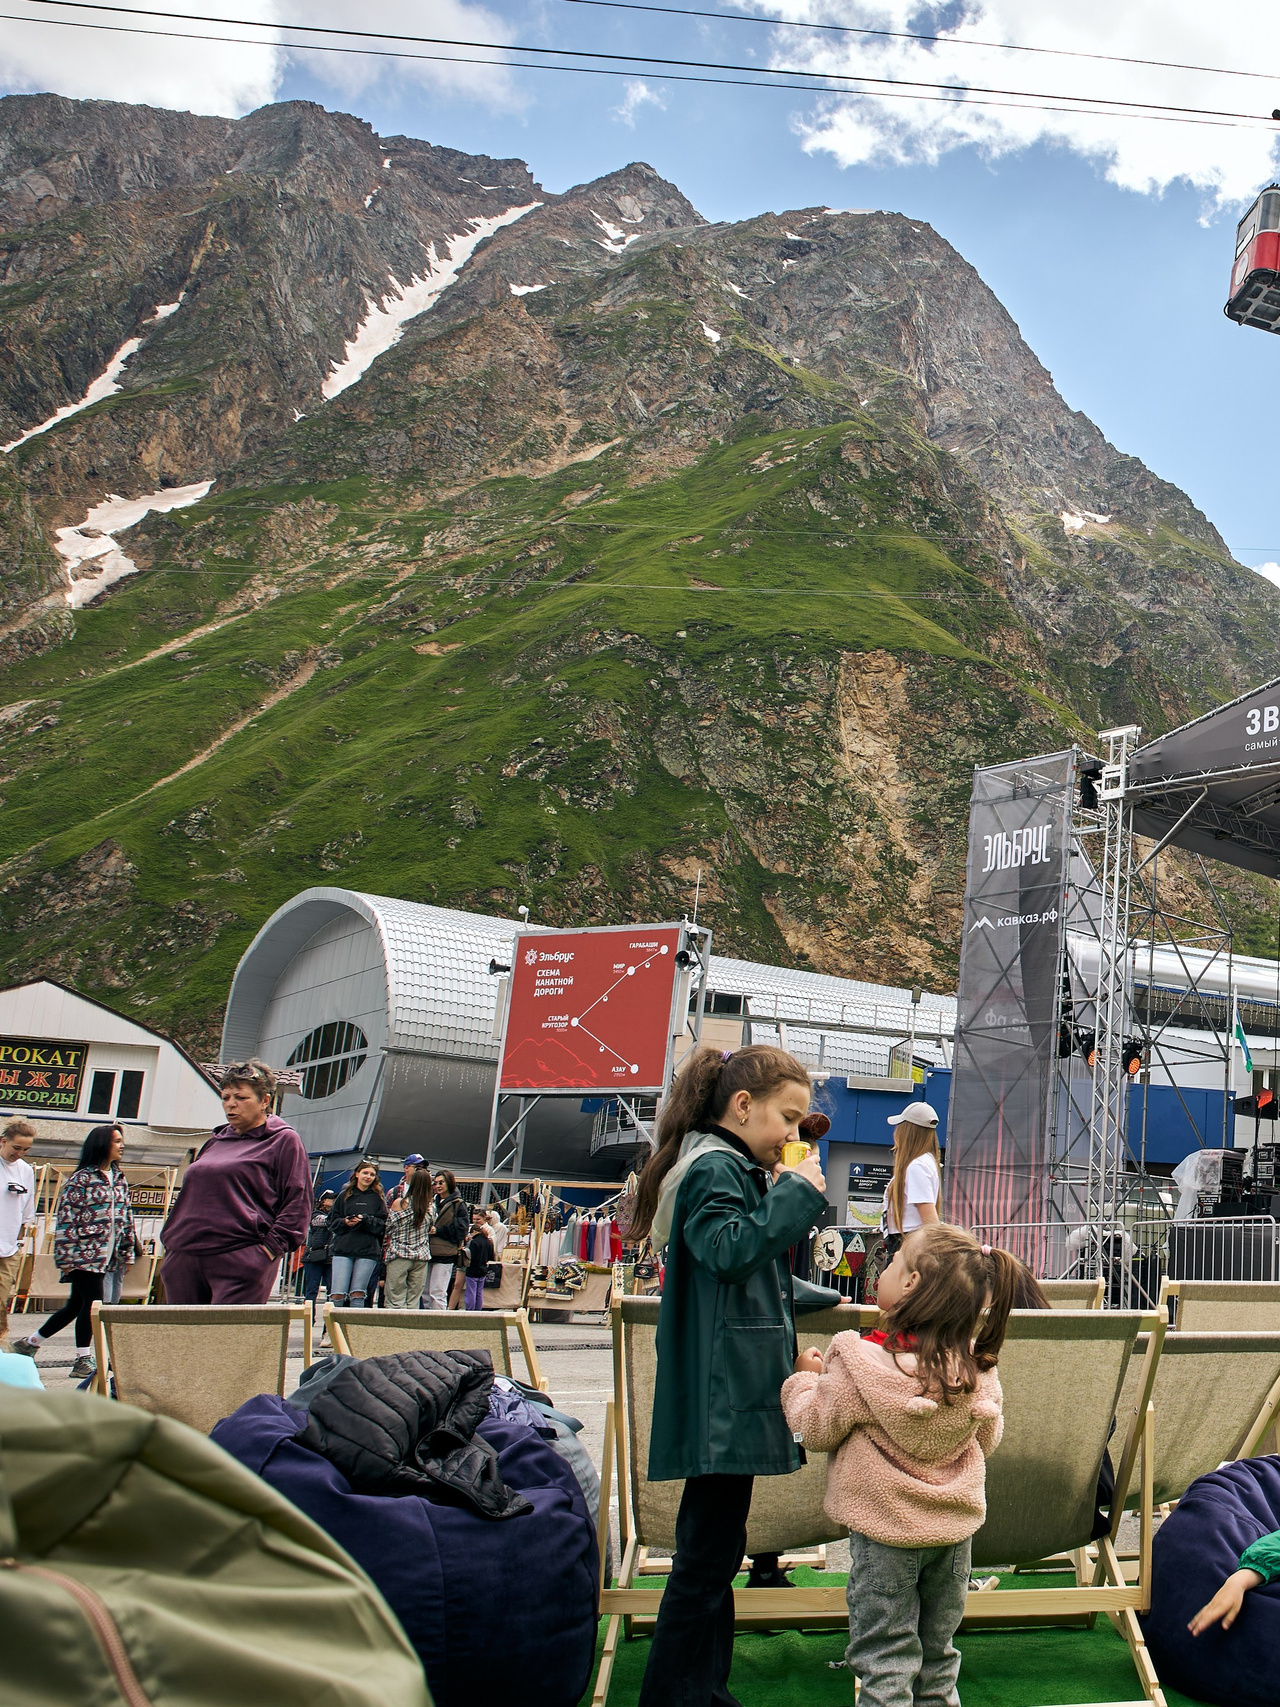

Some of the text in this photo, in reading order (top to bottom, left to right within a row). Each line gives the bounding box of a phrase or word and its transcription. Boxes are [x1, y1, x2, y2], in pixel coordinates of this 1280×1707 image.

[1245, 735, 1278, 751] самый
[982, 824, 1052, 873] ЭЛЬБРУС
[997, 908, 1058, 927] кавказ.рф
[629, 941, 659, 949] ГАРАБАШИ
[538, 951, 575, 964] Эльбрус
[536, 968, 561, 977] СХЕМА
[535, 977, 574, 987] КАНАТНОЙ
[534, 987, 564, 997] ДОРОГИ
[548, 1014, 569, 1022] СТАРЫЙ
